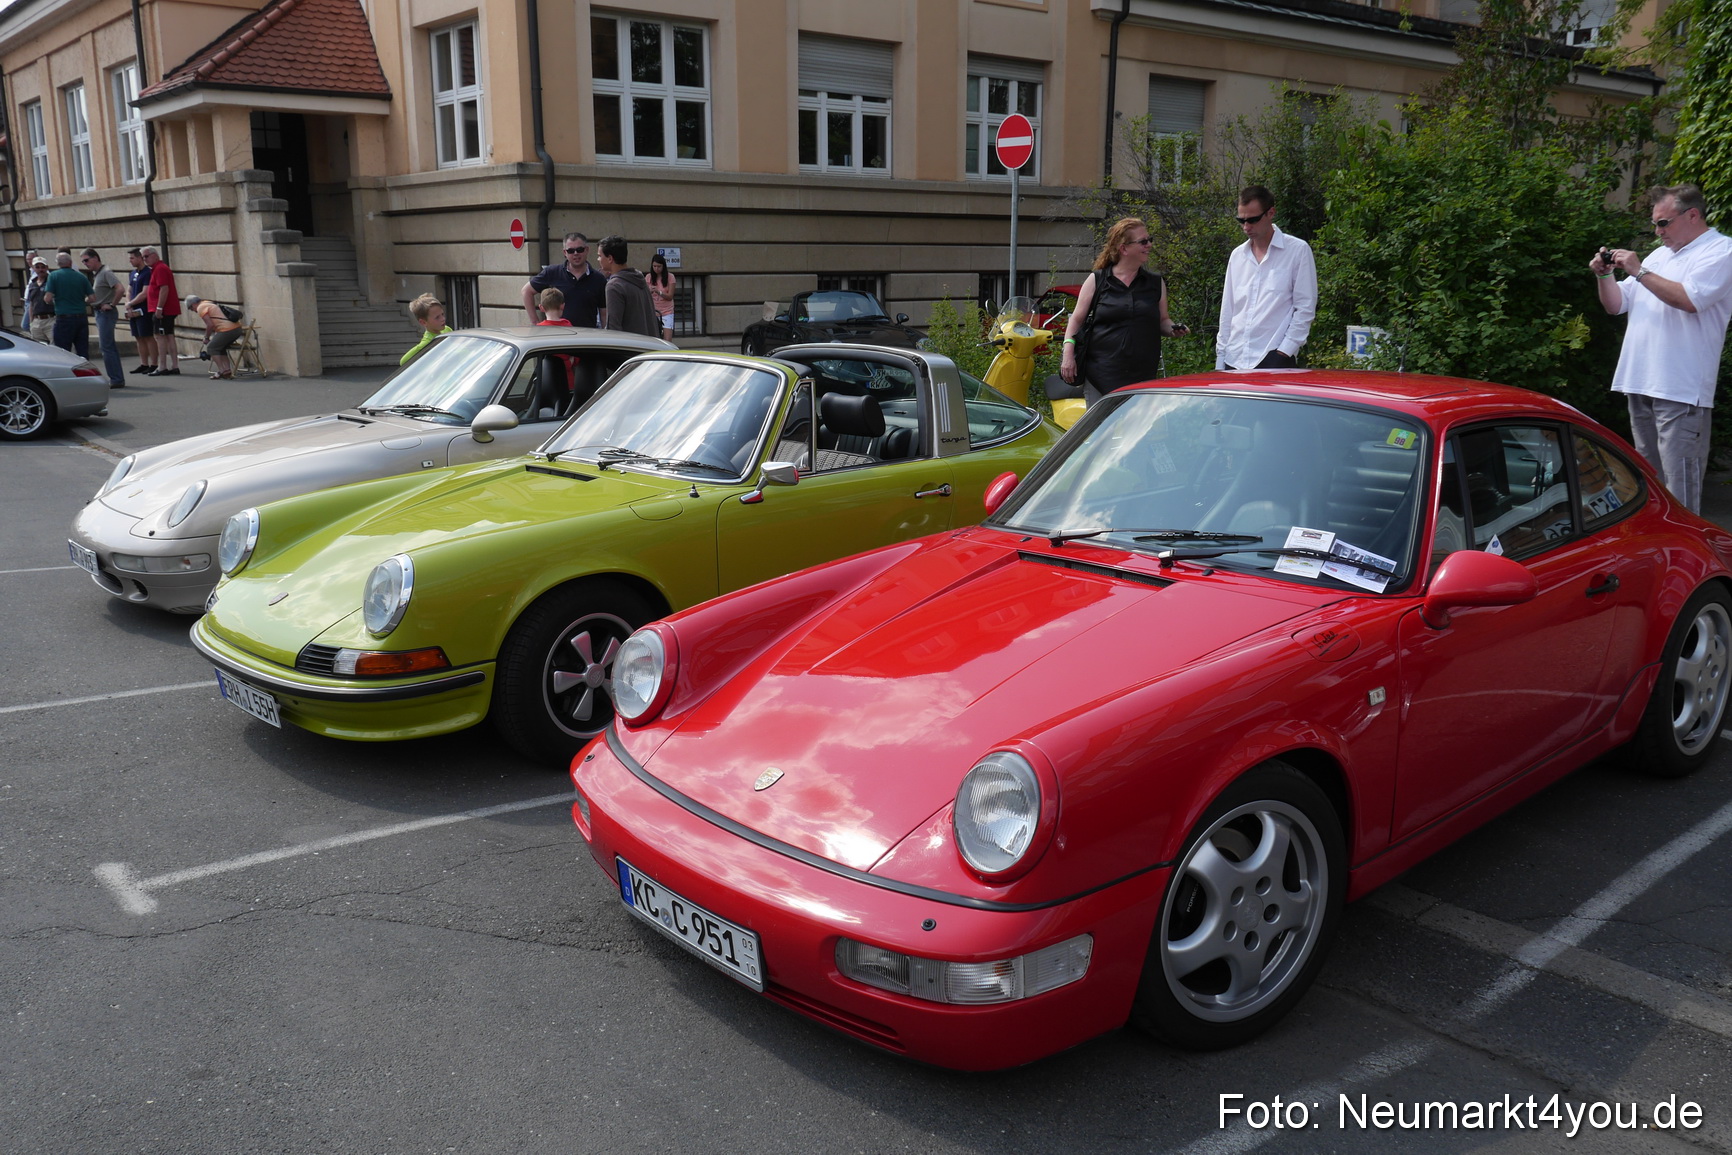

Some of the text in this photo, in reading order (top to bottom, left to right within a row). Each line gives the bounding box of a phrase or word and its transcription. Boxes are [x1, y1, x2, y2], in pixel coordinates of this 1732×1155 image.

[1354, 334, 1367, 351] P
[940, 436, 967, 444] targa
[252, 693, 277, 723] 55H
[630, 872, 659, 918] KC
[671, 900, 688, 936] C
[691, 912, 740, 968] 951
[741, 937, 754, 951] 03
[746, 963, 757, 976] 10
